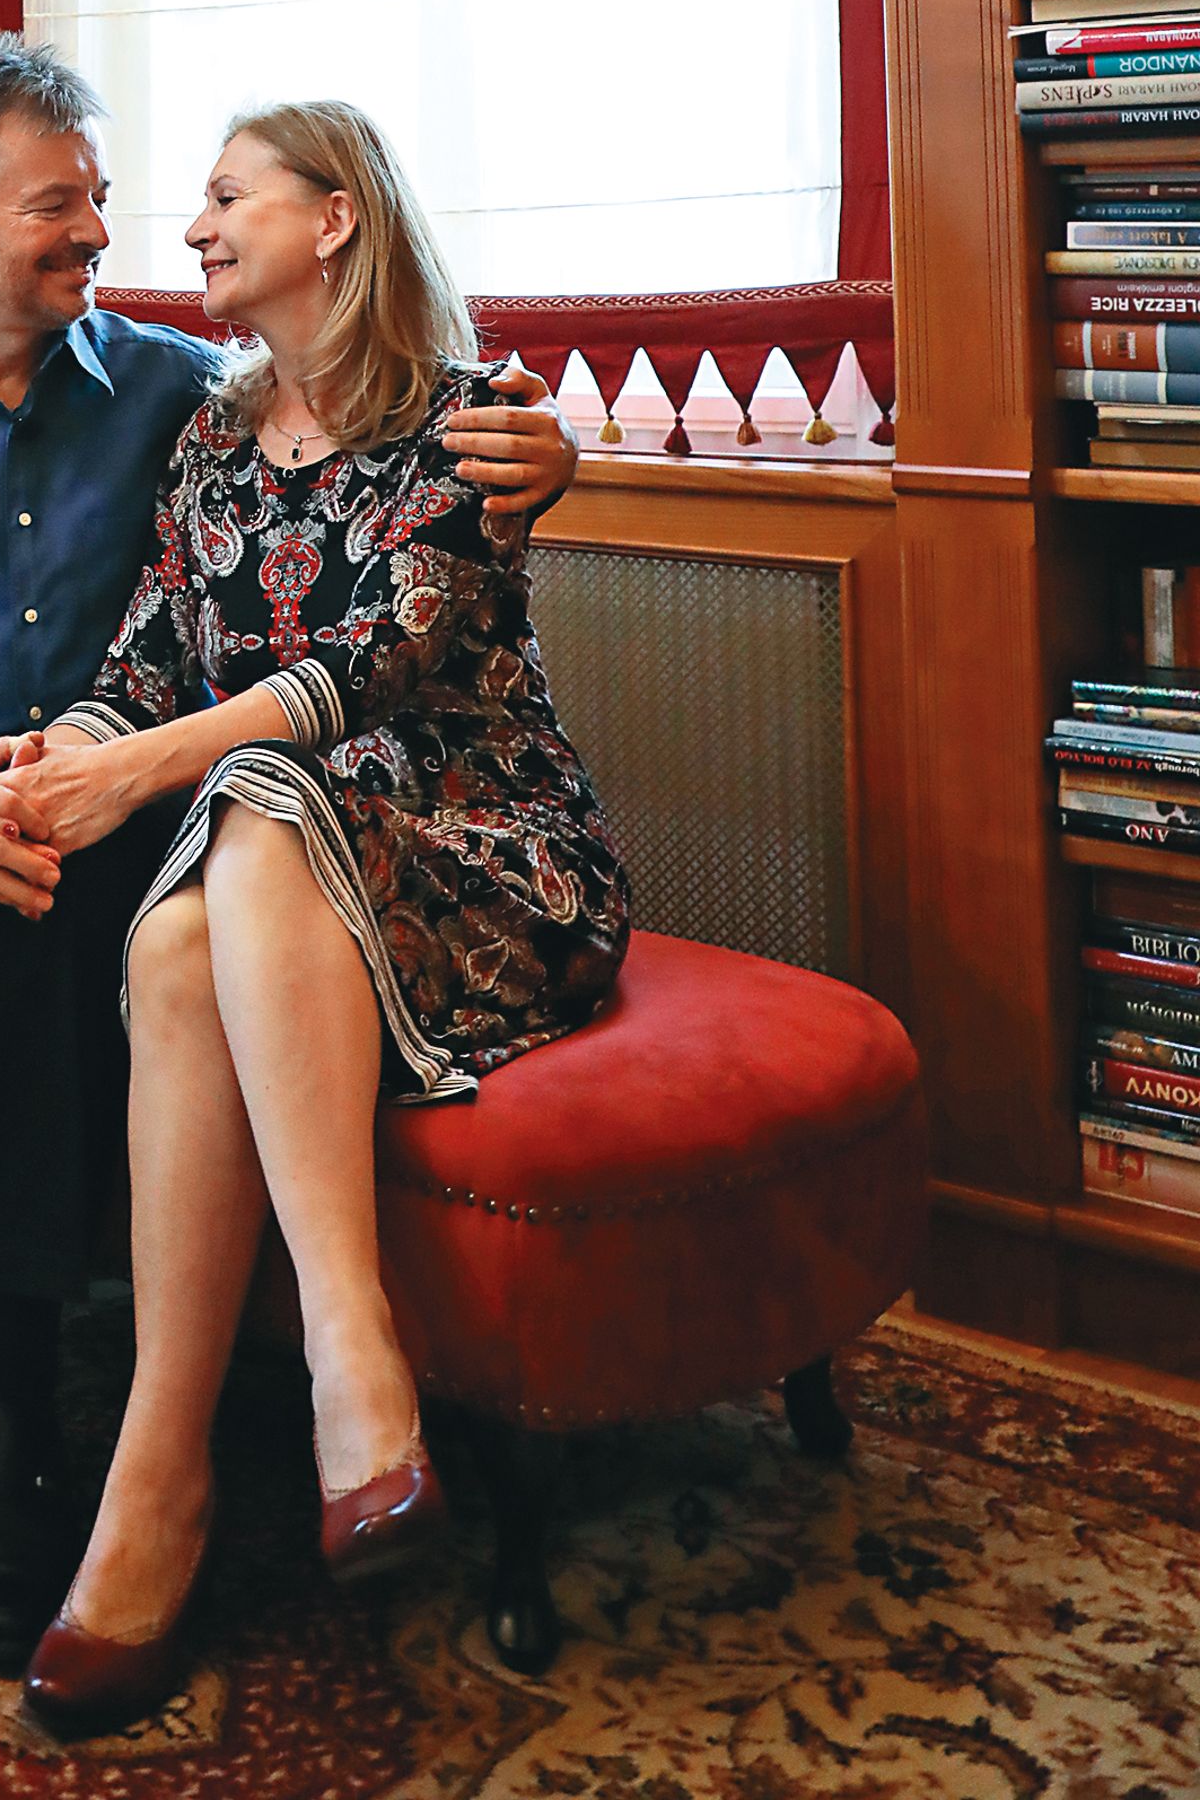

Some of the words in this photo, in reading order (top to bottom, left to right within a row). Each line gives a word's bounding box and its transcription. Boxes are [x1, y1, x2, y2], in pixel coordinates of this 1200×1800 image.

[1040, 84, 1112, 104] SAPIENS
[1118, 83, 1165, 95] HARARI
[1122, 111, 1168, 123] HARARI
[1130, 232, 1171, 244] lakott
[1178, 232, 1187, 244] A
[1117, 284, 1165, 294] emlékeim
[1091, 296, 1129, 311] RICE
[1136, 760, 1152, 771] AZ
[1131, 935, 1200, 963] BIBLIO
[1170, 1050, 1200, 1068] AM
